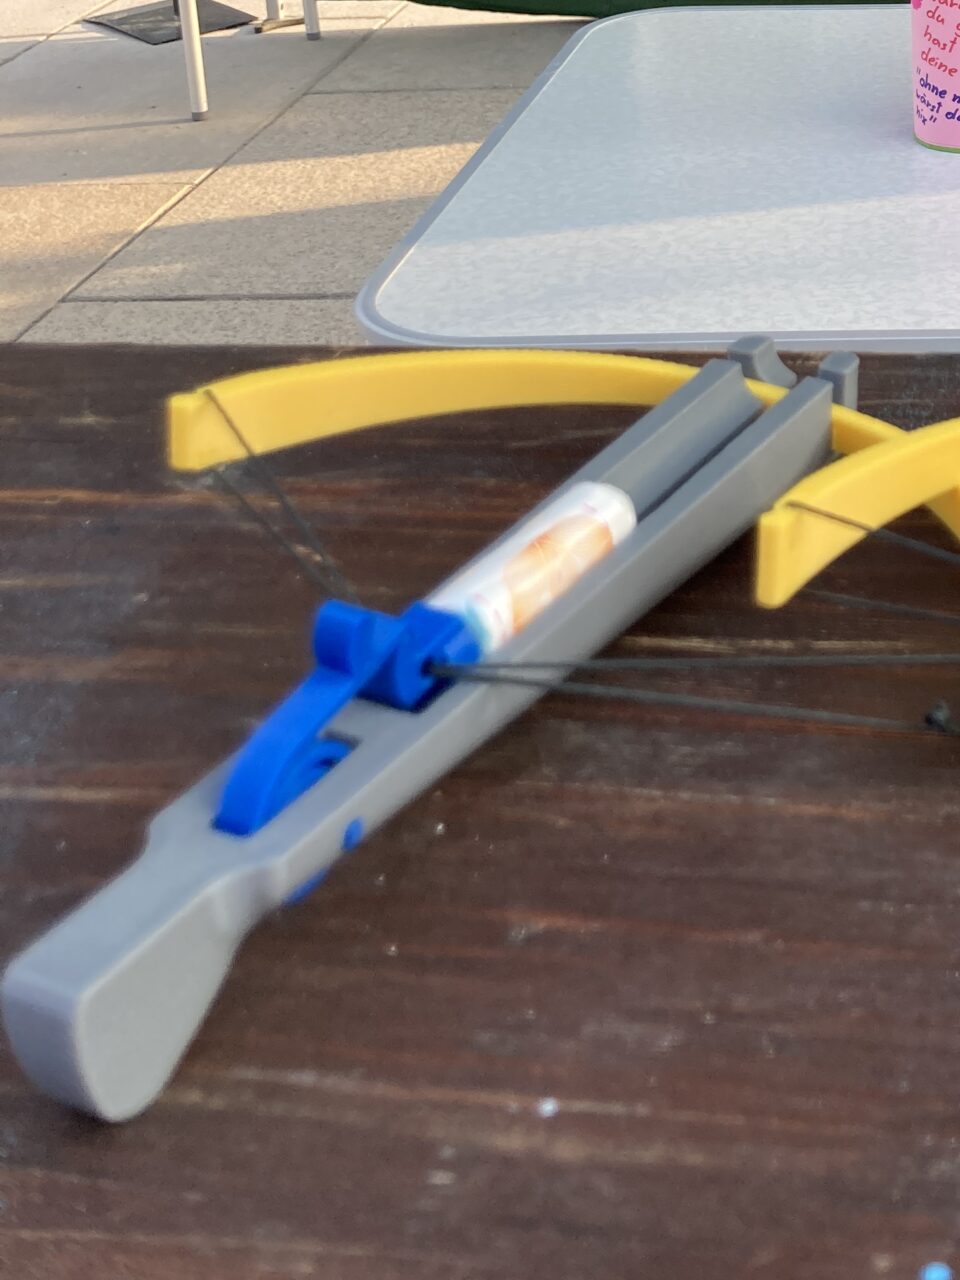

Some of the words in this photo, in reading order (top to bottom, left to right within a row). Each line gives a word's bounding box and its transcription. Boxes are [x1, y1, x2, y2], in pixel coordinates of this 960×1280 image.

[926, 5, 945, 25] du
[924, 25, 957, 53] hast
[921, 48, 958, 77] deine
